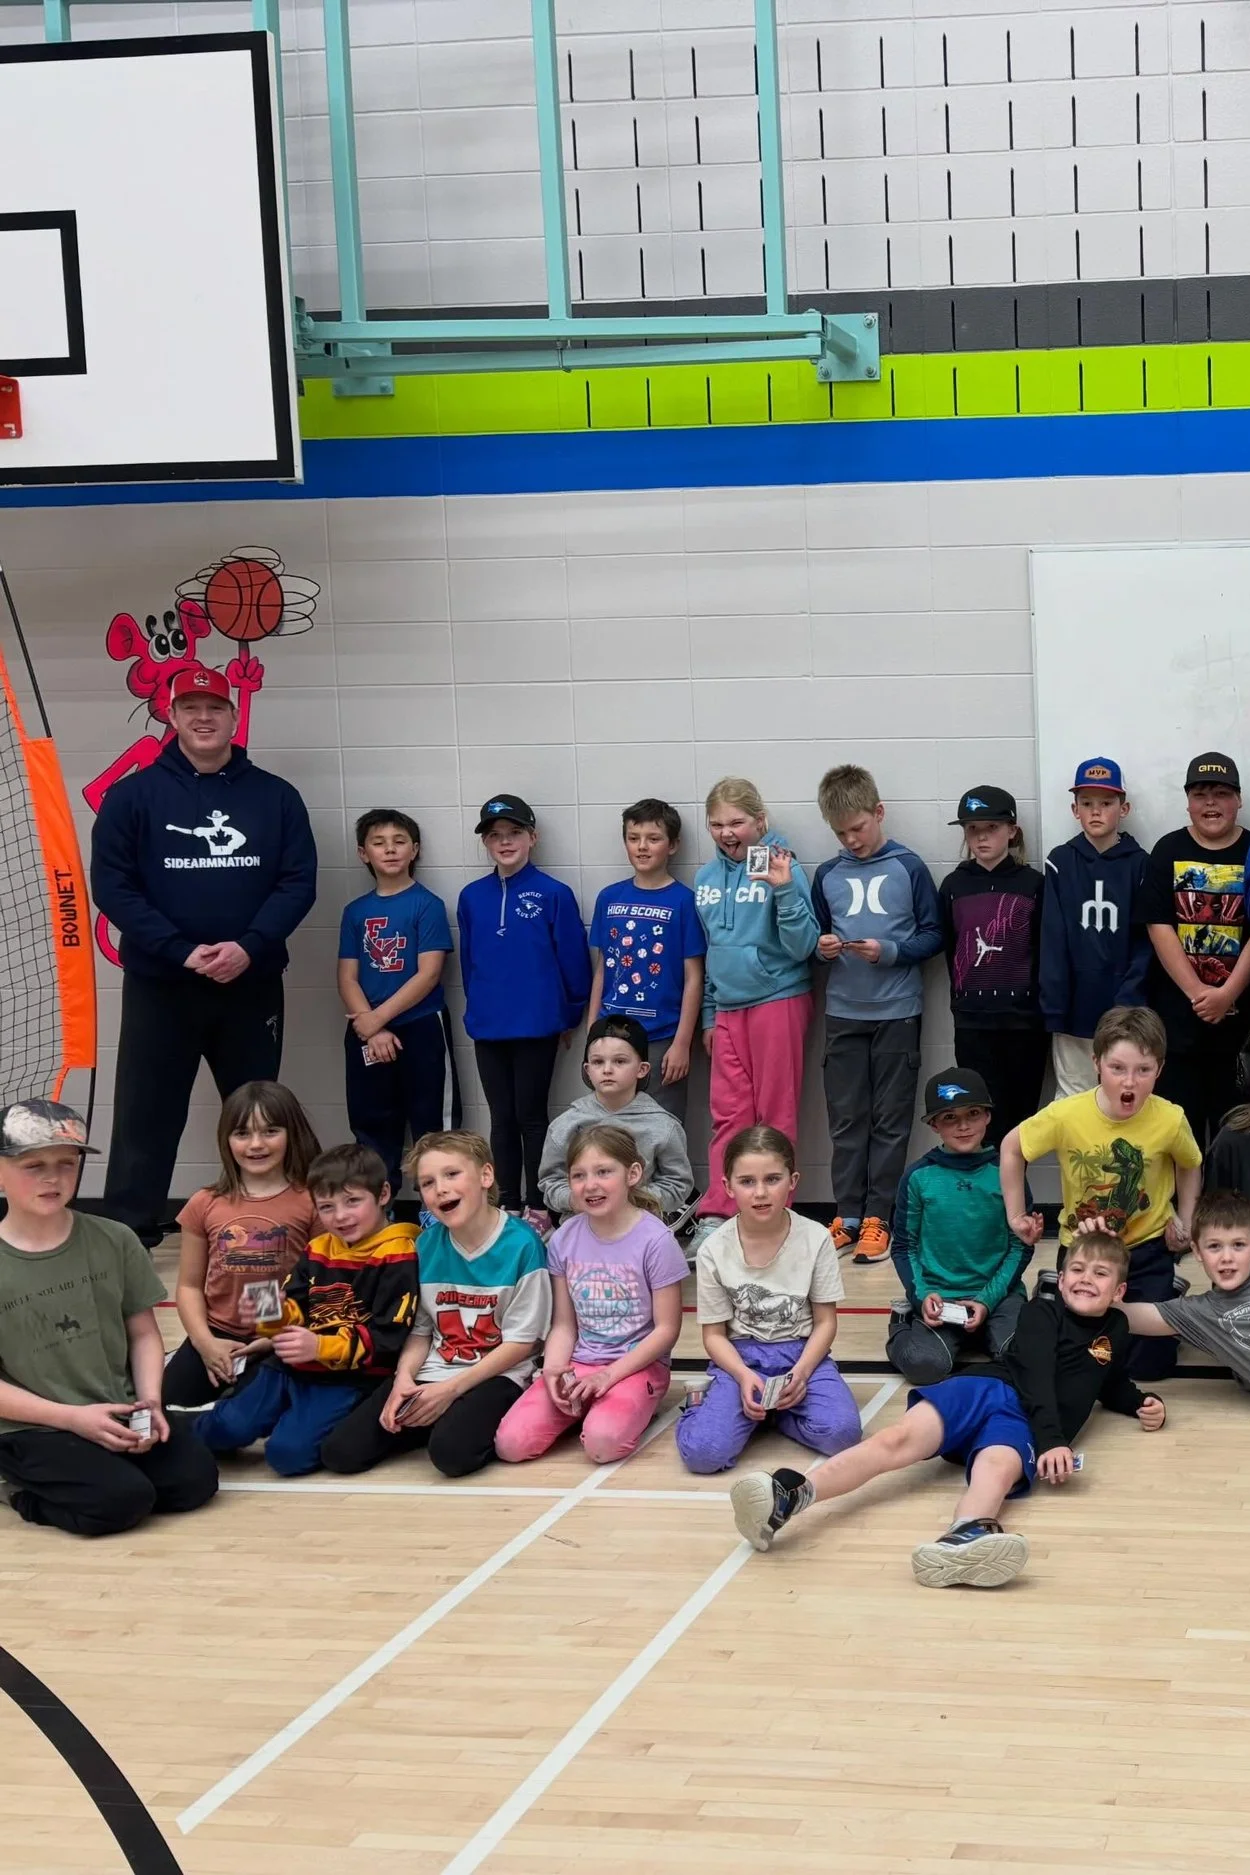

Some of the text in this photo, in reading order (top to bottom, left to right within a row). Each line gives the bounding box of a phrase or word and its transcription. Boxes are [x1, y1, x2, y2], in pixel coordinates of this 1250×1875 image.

[164, 856, 261, 869] SIDEARMNATION
[517, 891, 543, 899] BENTLEY
[55, 869, 81, 947] BOWNET
[607, 905, 672, 921] HIGH SCORE!
